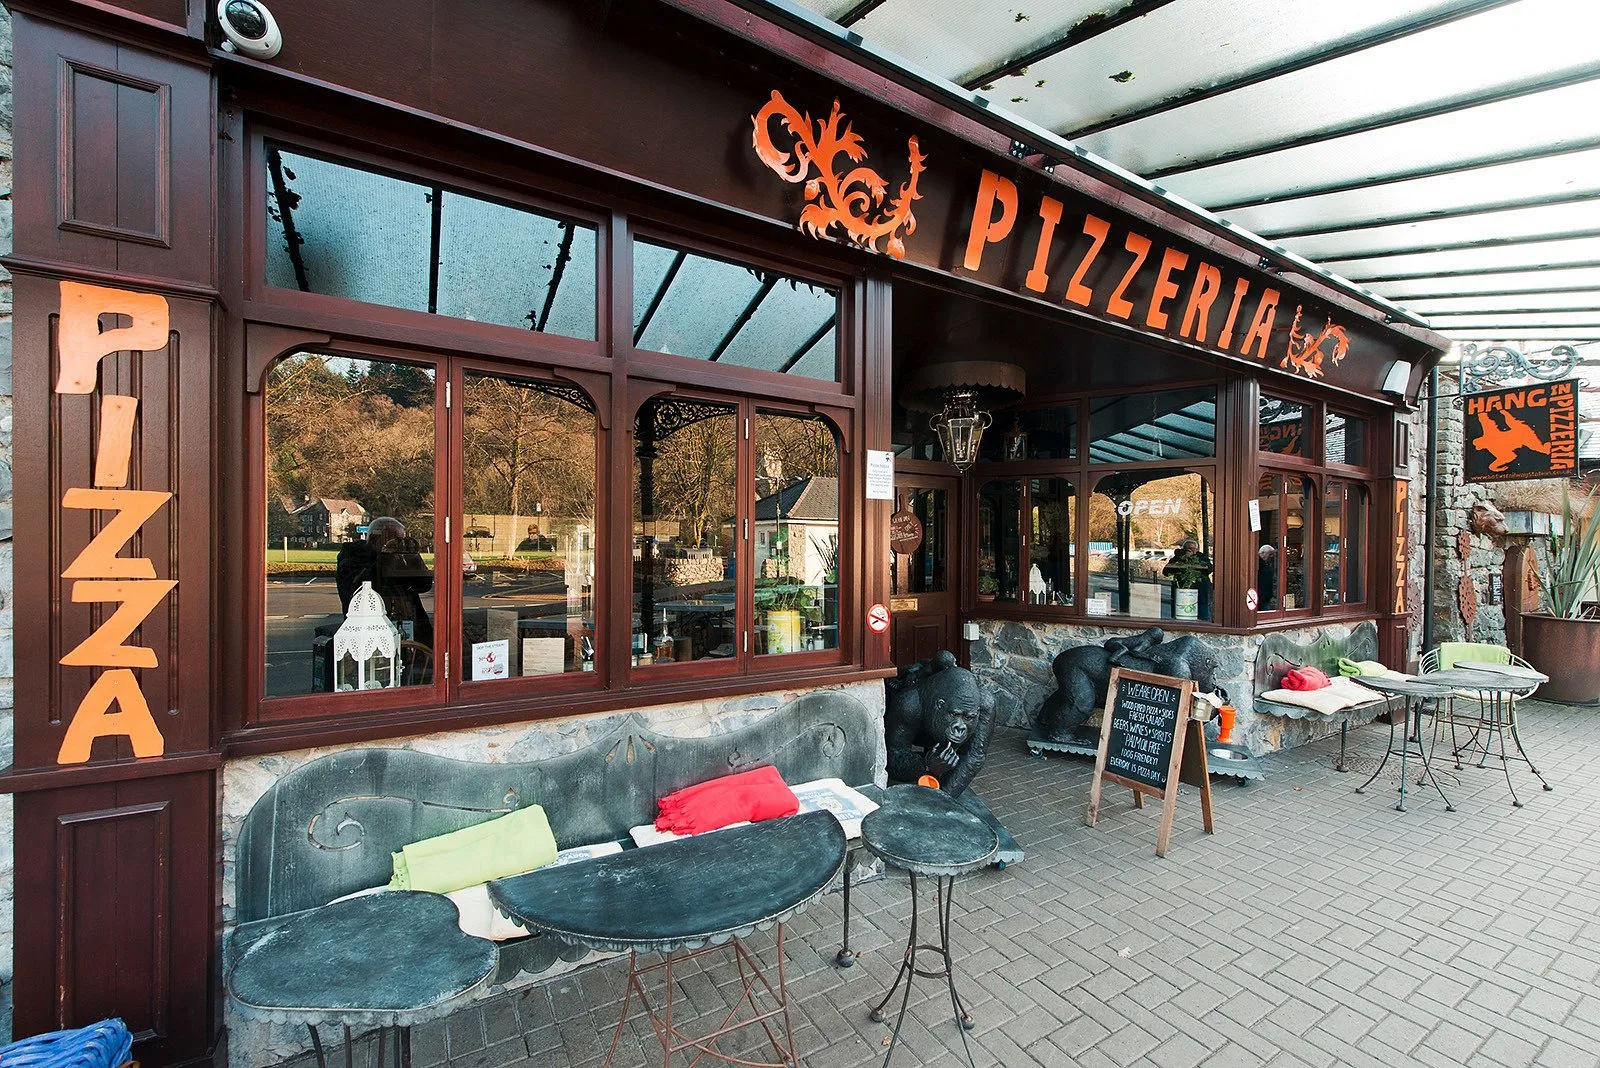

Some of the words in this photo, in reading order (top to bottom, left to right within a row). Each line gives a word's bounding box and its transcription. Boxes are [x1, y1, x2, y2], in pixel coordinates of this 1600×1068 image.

[963, 168, 1280, 359] PIZZERIA
[1468, 388, 1547, 415] HANG
[1550, 383, 1571, 396] IN
[1549, 393, 1575, 471] PIZZERIA
[1117, 498, 1182, 516] OPEN
[55, 280, 179, 765] PIZZA
[1394, 480, 1408, 614] PIZZA
[1127, 683, 1140, 697] WE
[1140, 685, 1151, 699] ARE
[1151, 687, 1170, 703] OPEN
[1129, 711, 1145, 722] FRESH
[1145, 714, 1165, 728] SALADS
[1146, 705, 1159, 716] PIZZA
[1161, 708, 1175, 720] SIDES
[1130, 722, 1148, 736] WINES
[1151, 728, 1172, 744] SPIRITS
[1137, 765, 1150, 778] PIZZA
[1150, 770, 1161, 782] DAY
